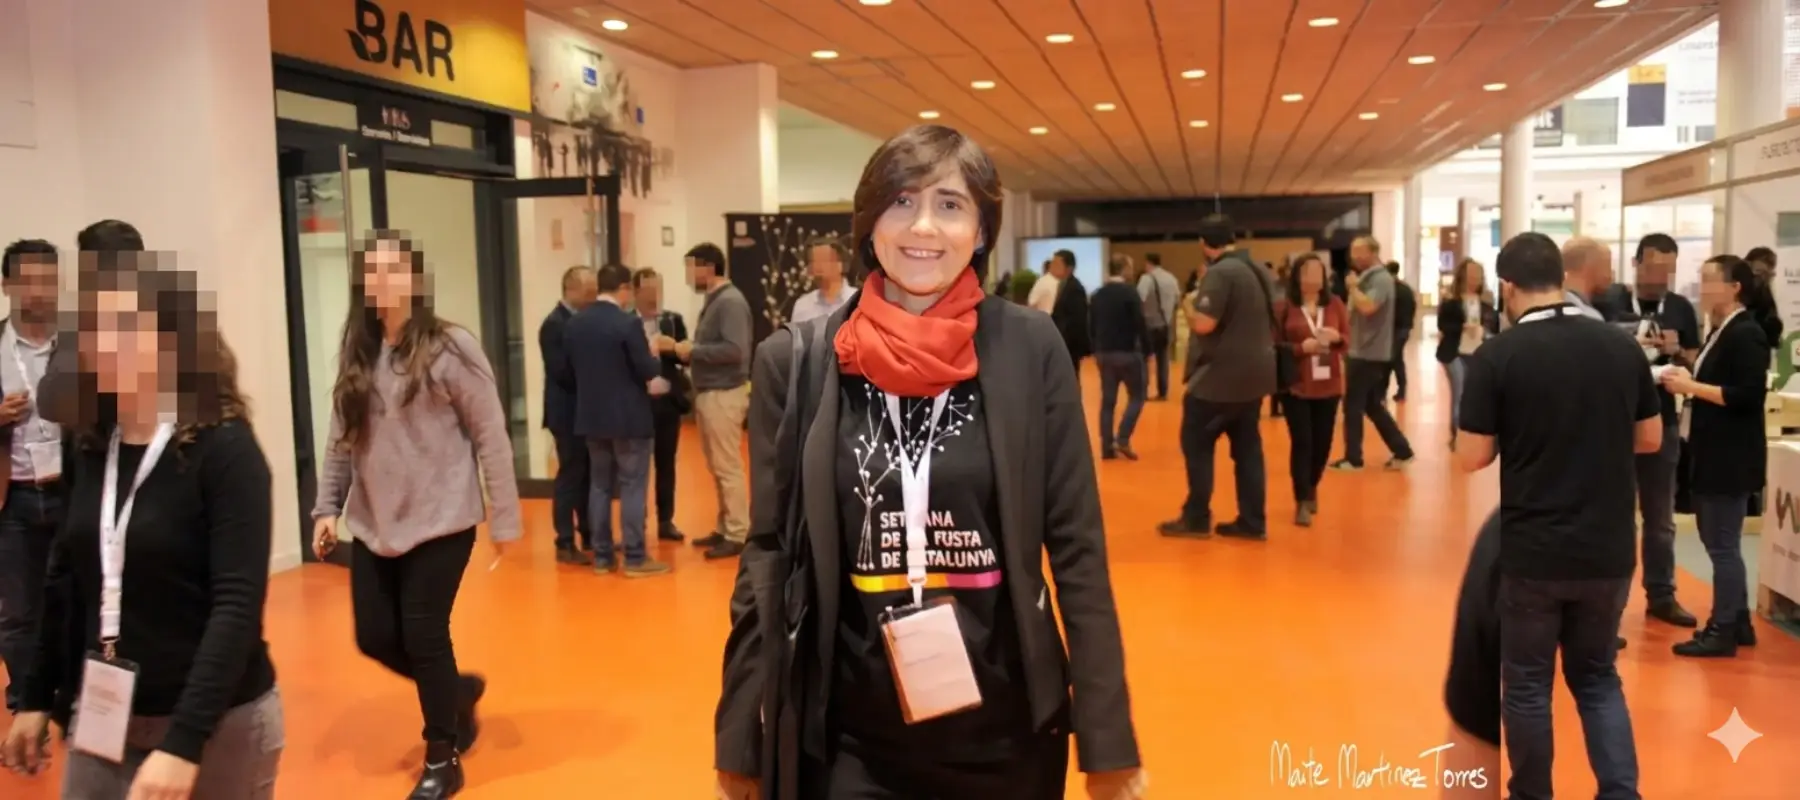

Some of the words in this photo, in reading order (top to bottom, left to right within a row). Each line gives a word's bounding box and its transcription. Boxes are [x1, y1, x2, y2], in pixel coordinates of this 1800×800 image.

[344, 0, 455, 81] BAR
[881, 532, 901, 548] DE
[934, 530, 982, 547] FUSTA
[881, 552, 901, 568] DE
